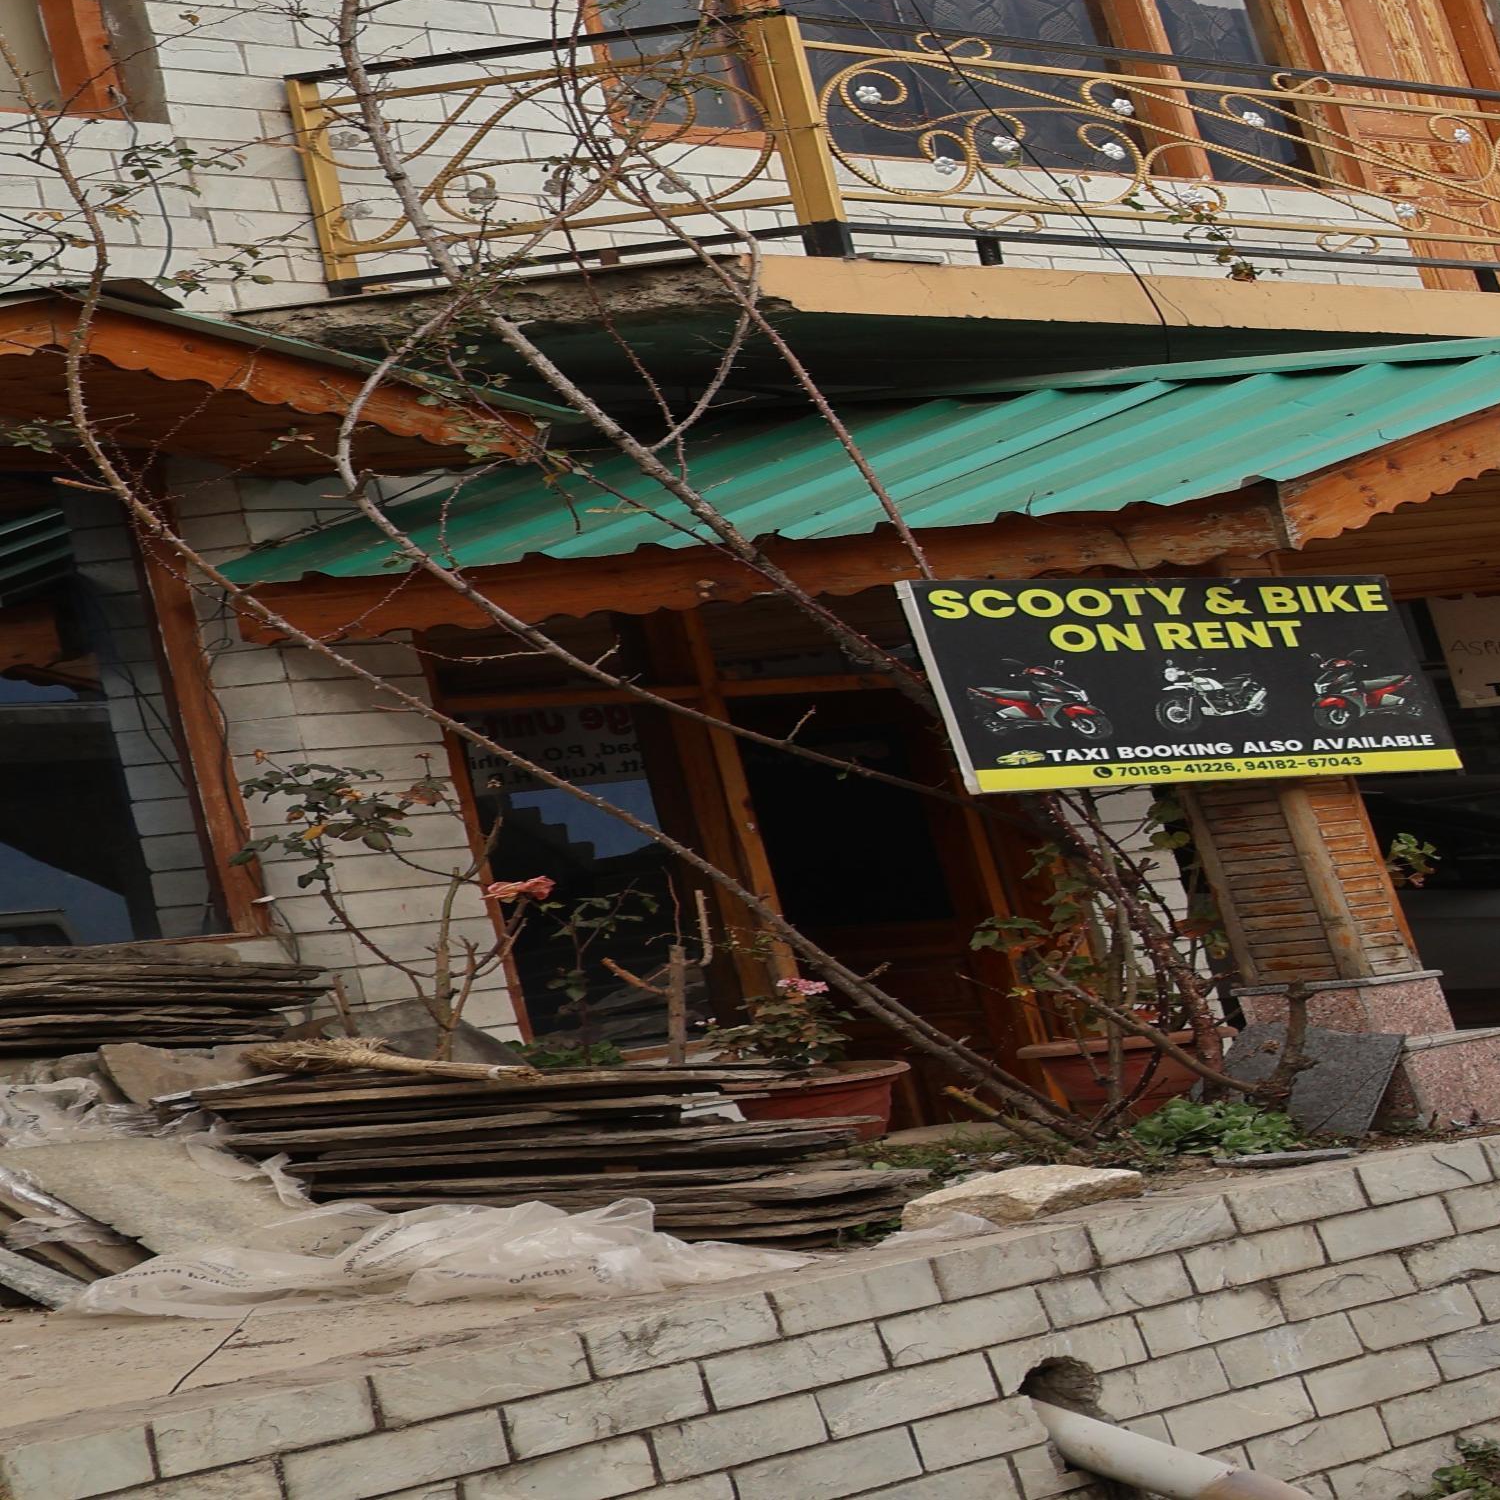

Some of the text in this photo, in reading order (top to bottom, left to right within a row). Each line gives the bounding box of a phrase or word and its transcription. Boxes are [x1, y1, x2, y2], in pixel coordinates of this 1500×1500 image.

[928, 584, 1390, 619] SCOOTY & BIKE
[1050, 620, 1303, 653] ON RENT
[1047, 734, 1435, 764] TAXI BOOKING ALSO AVAILABLE
